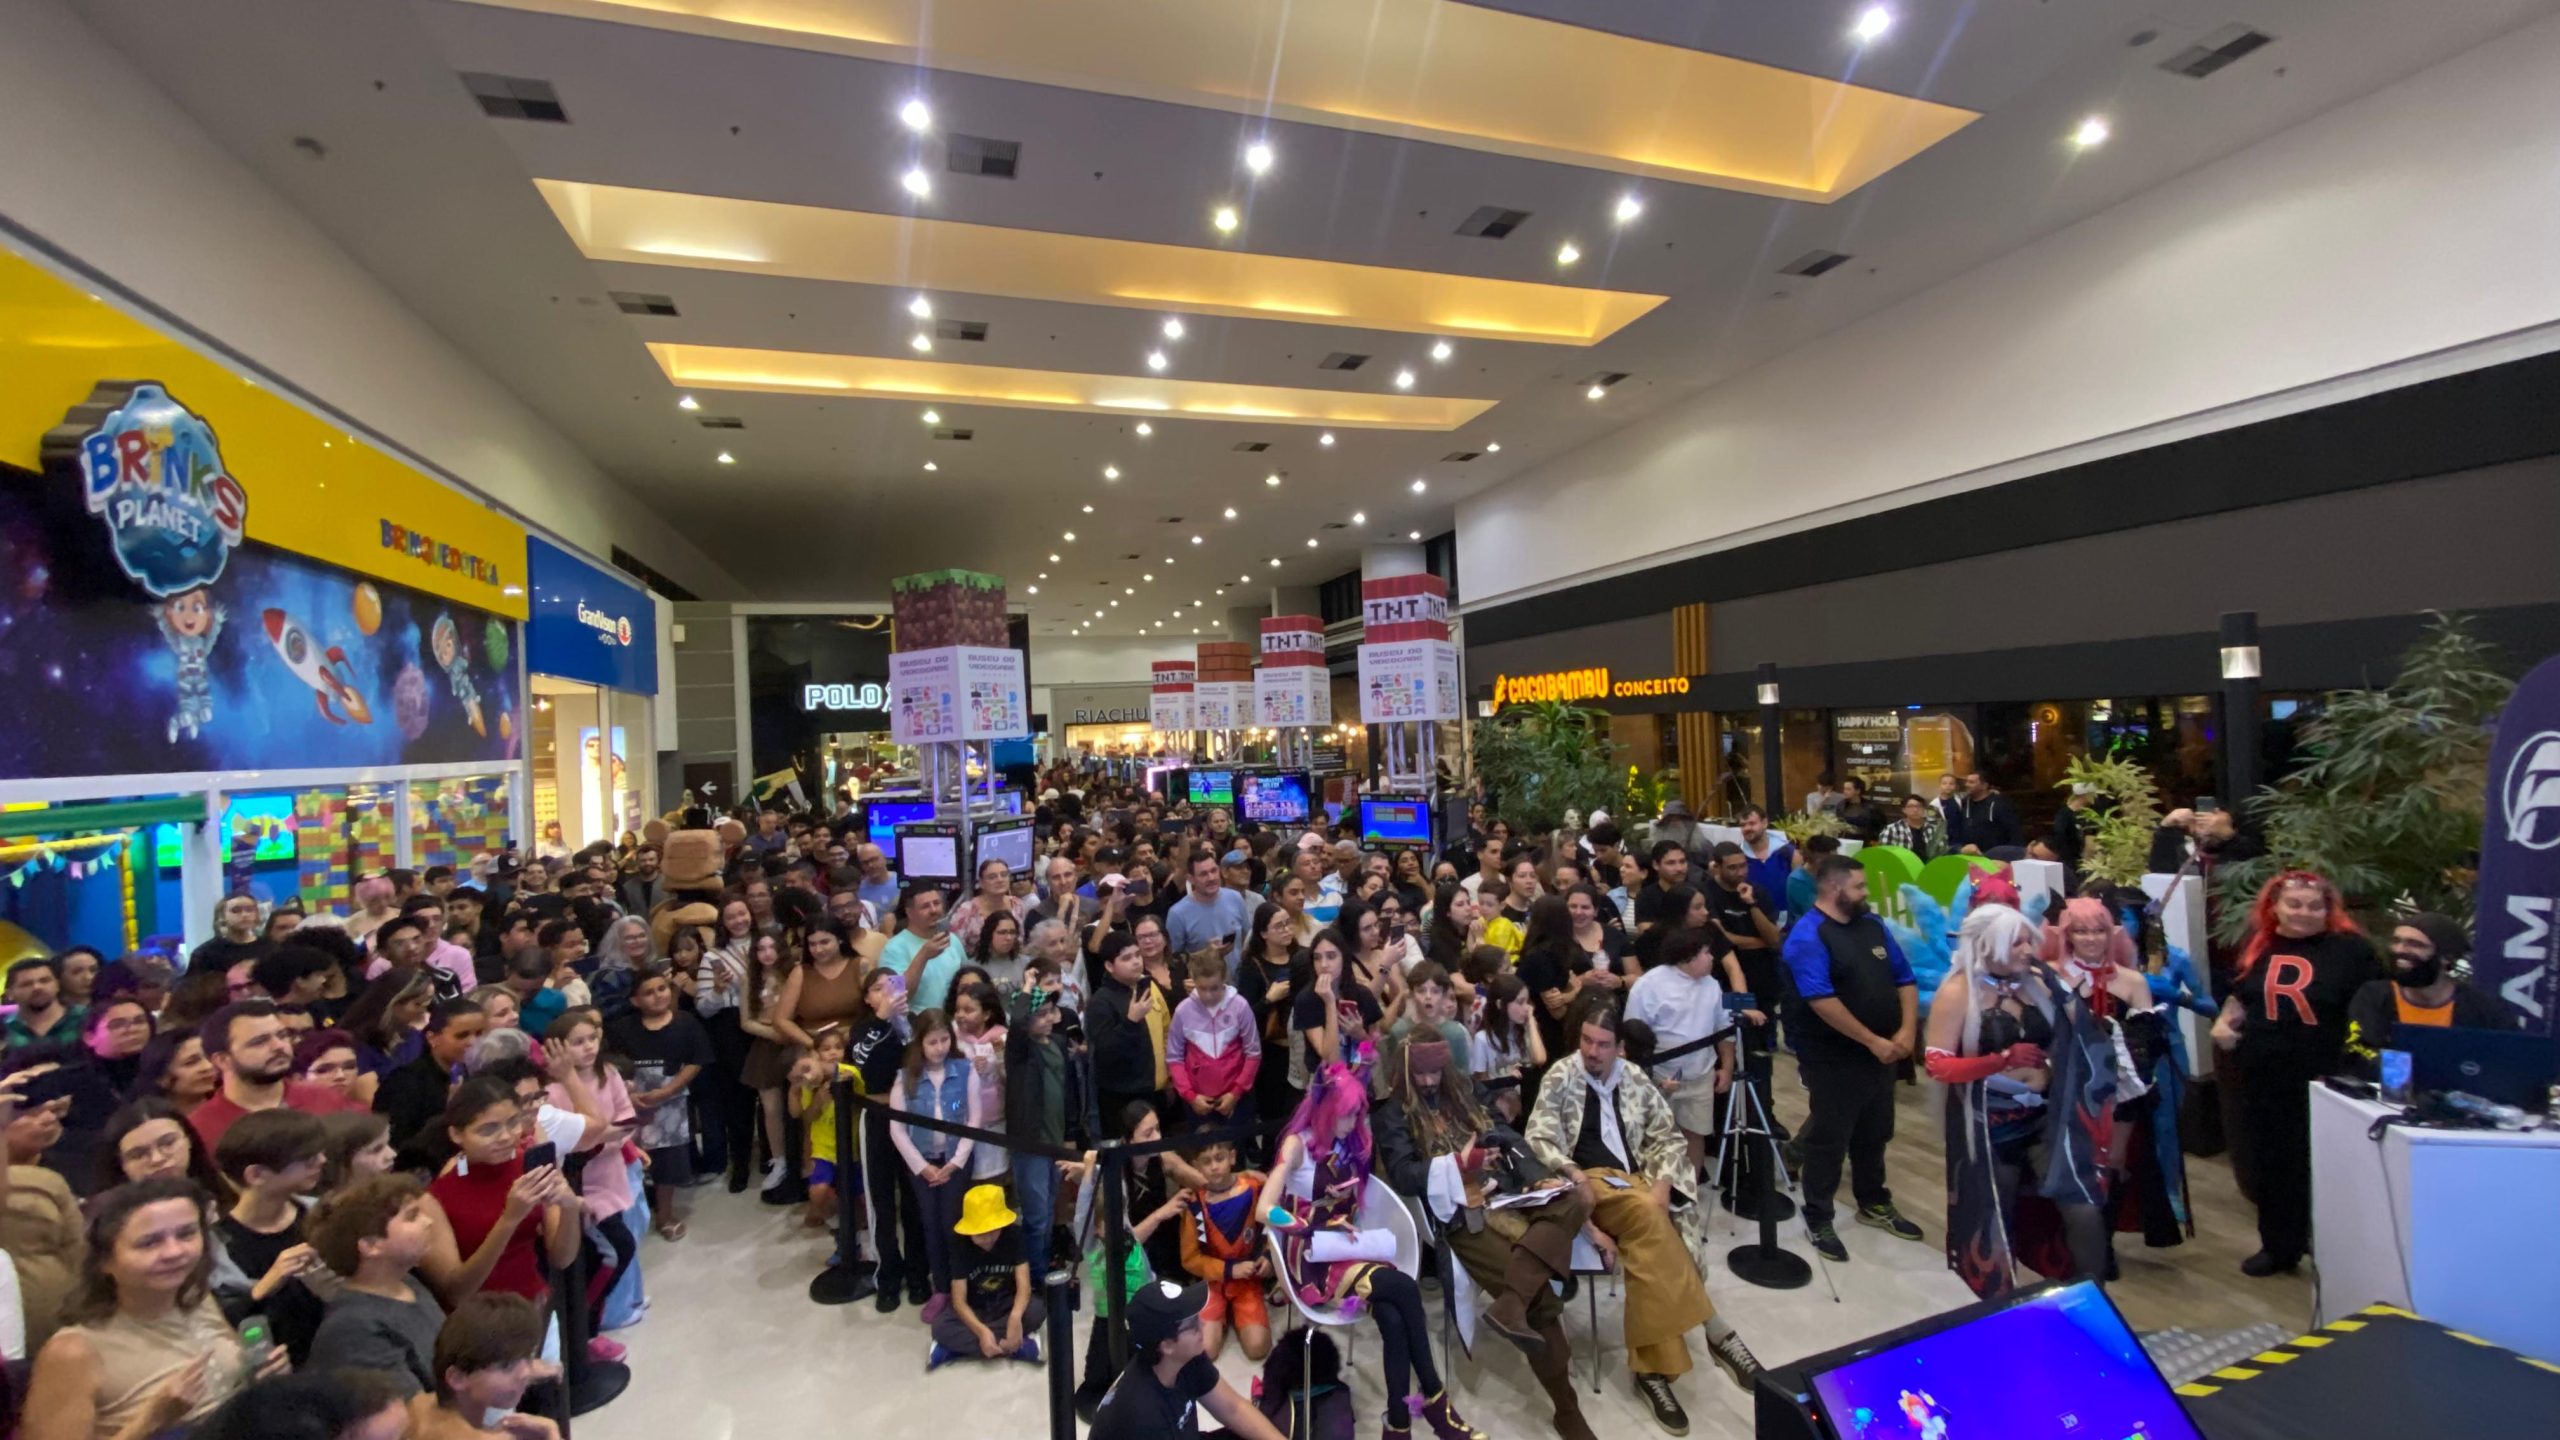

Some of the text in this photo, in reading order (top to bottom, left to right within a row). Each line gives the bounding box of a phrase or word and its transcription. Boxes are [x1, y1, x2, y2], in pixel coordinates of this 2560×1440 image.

[85, 425, 245, 532] BRINKS
[116, 499, 201, 543] PLANET
[379, 518, 499, 587] BRINQUEDOTECA
[1369, 600, 1419, 621] TNT
[1428, 597, 1446, 619] TNT
[1265, 634, 1302, 650] TNT
[1154, 673, 1177, 683] TNT
[1507, 667, 1690, 704] COCOBAMBU CONCEITO
[804, 683, 883, 710] POLO
[1075, 707, 1150, 724] RIACHU
[1837, 715, 1900, 728] HAPPY HOUR
[2500, 895, 2553, 1029] AM
[2264, 954, 2319, 1026] R
